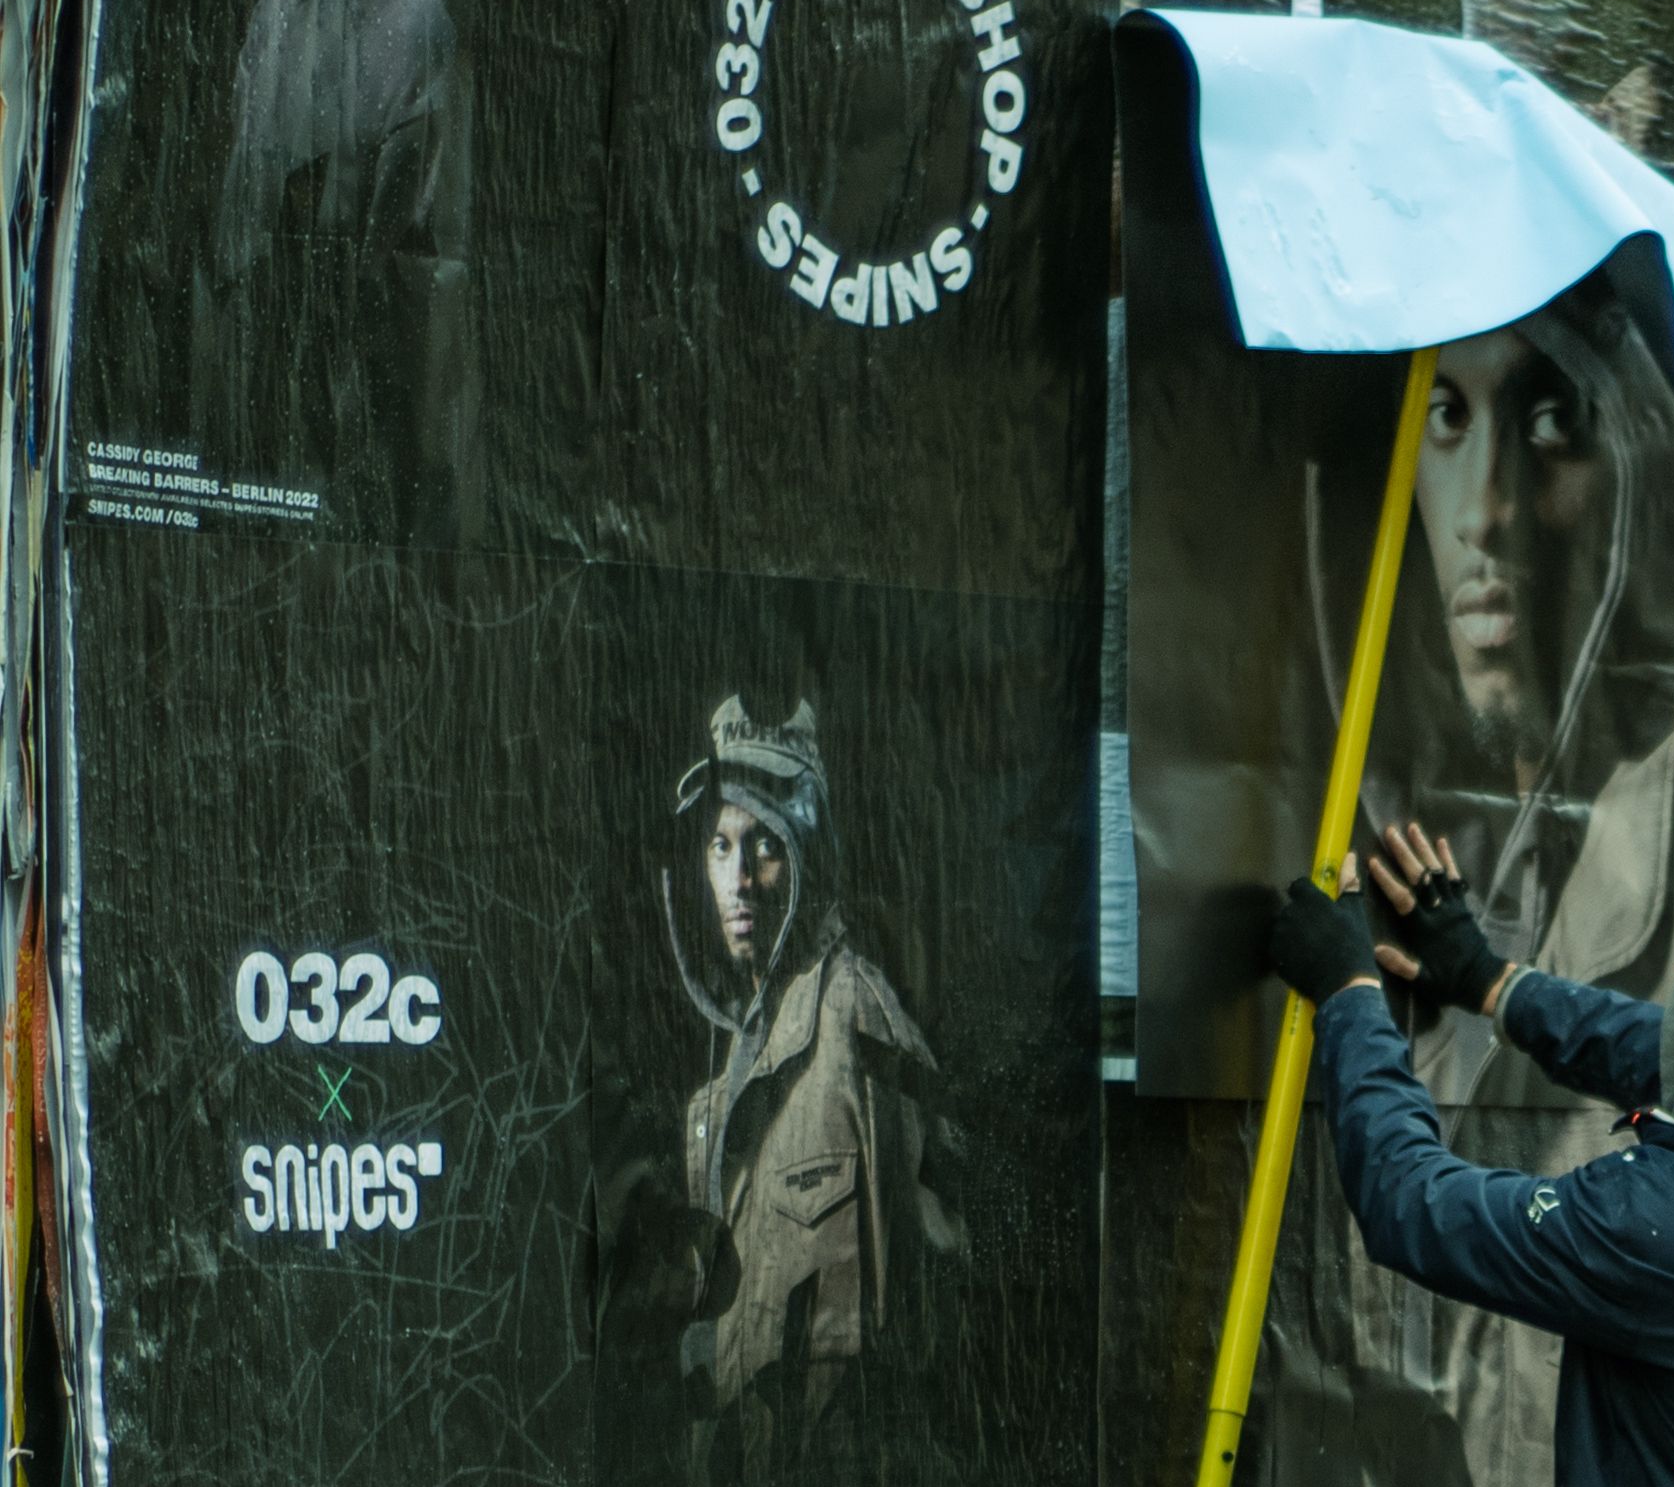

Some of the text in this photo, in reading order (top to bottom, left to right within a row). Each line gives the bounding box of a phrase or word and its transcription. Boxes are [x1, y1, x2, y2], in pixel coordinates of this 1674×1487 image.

[756, 200, 974, 327] SNIPES
[86, 441, 199, 472] CASSIDY GEORGE
[88, 463, 151, 487] BREAKING
[231, 482, 285, 505] BERLIN
[285, 490, 320, 509] 2022
[235, 951, 441, 1046] 032c
[243, 1142, 419, 1250] snipes
